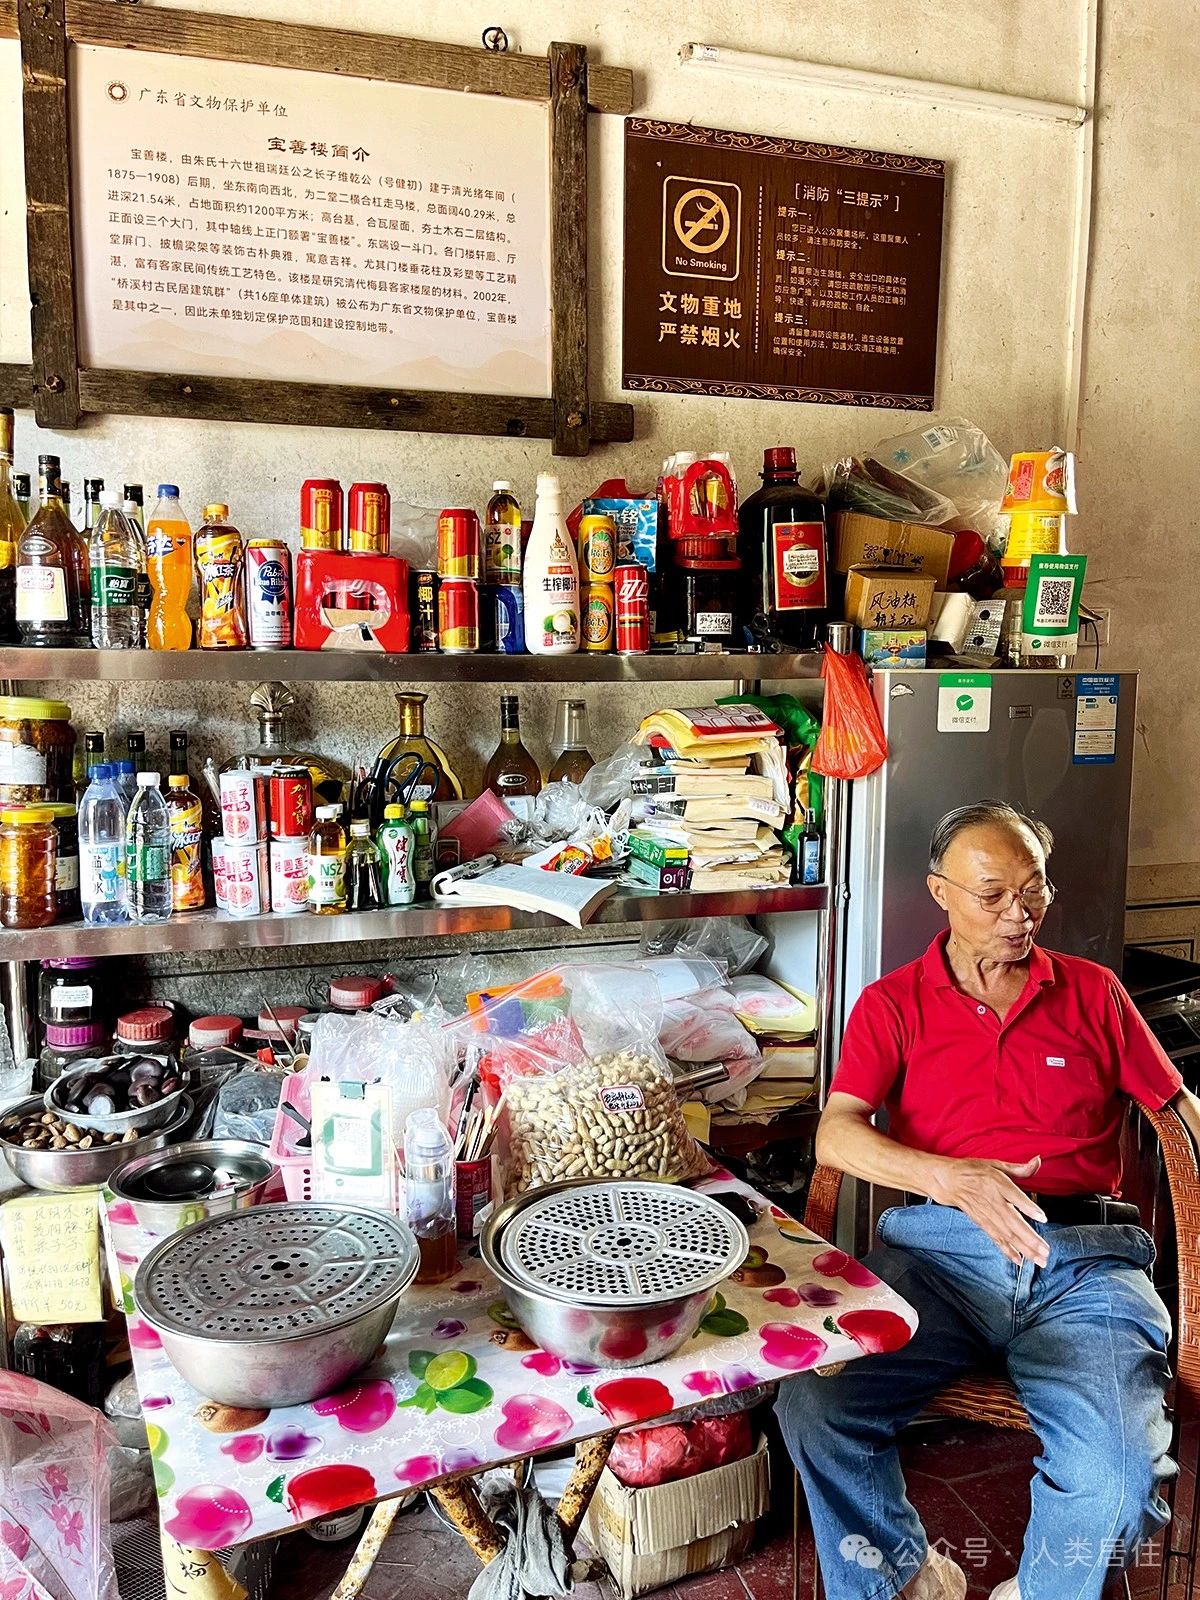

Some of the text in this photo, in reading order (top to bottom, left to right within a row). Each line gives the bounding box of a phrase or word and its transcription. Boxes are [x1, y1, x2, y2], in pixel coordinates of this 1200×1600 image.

[138, 87, 289, 117] 广东省文物保护单位
[267, 136, 371, 162] 宝善楼简介
[675, 256, 727, 271] No Smoking
[658, 291, 743, 319] 文物重地
[658, 322, 741, 349] 严禁烟火
[542, 577, 578, 592] 生榨椰汁
[418, 586, 434, 621] 椰汁
[869, 591, 918, 611] 风油精
